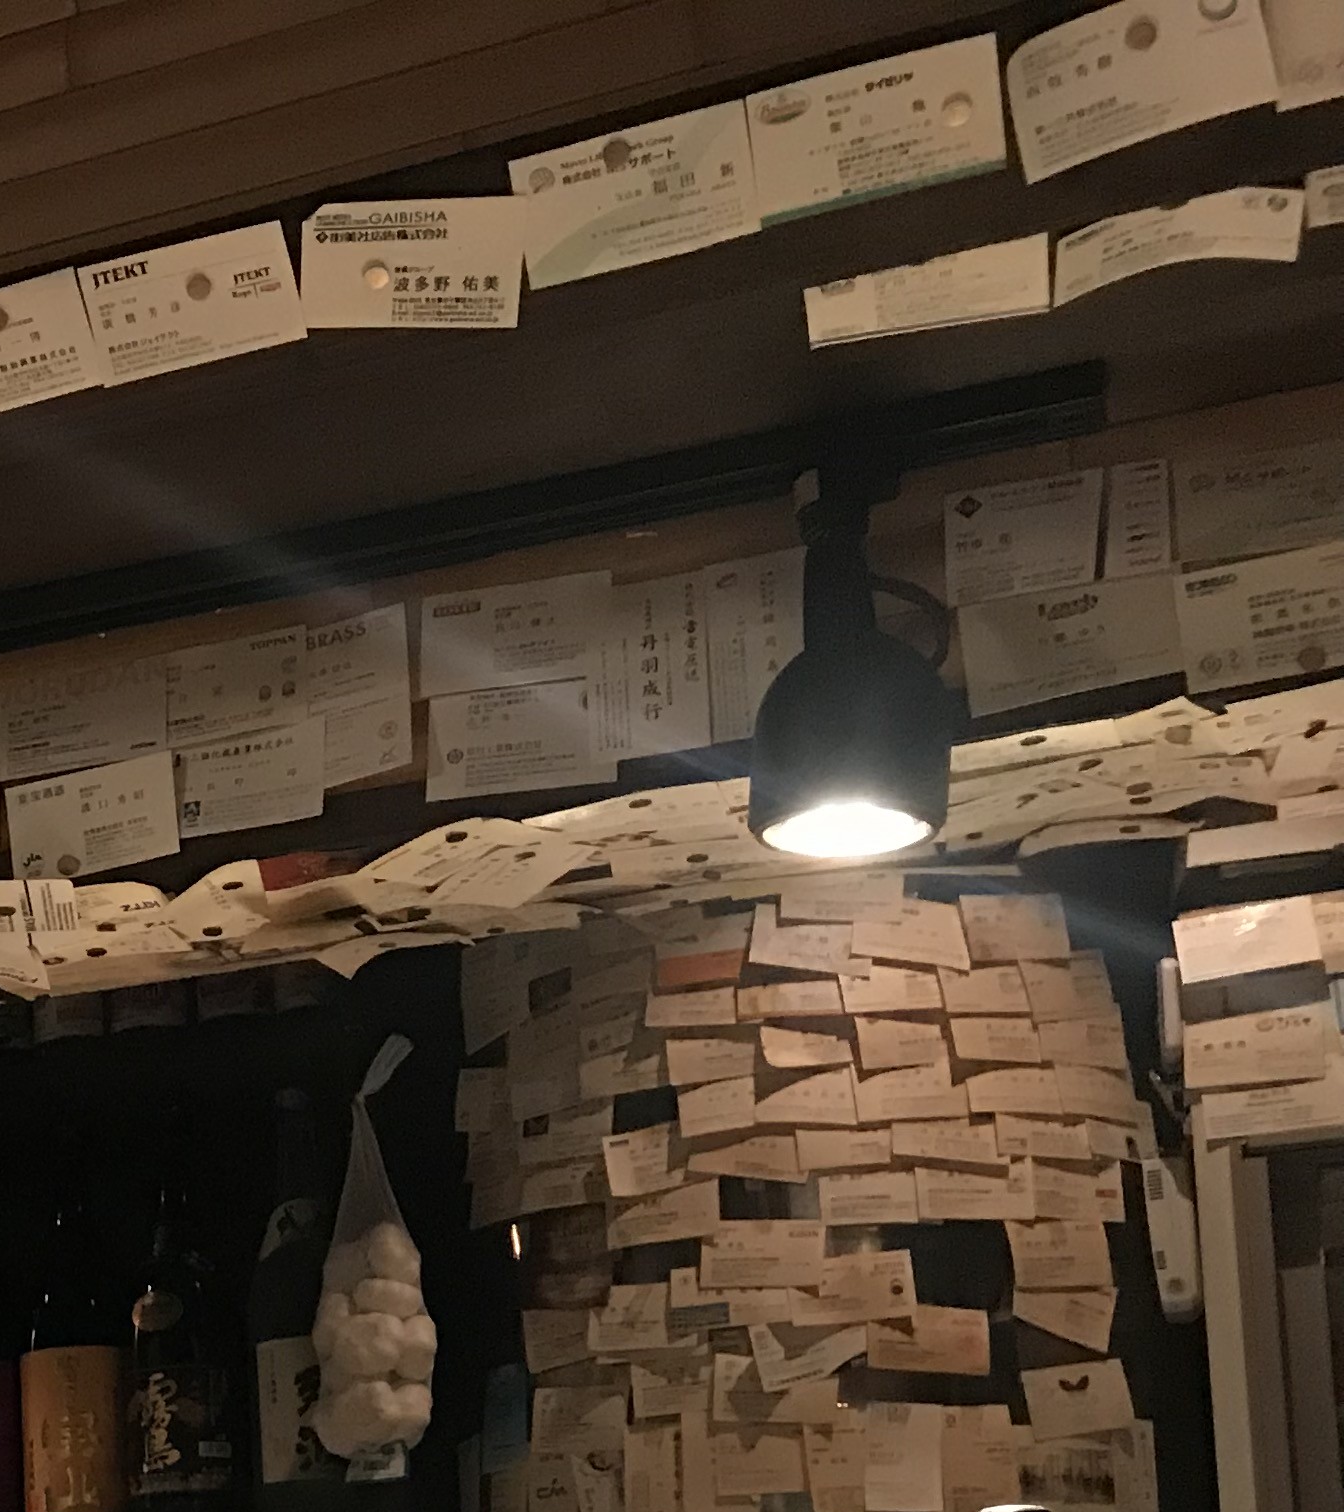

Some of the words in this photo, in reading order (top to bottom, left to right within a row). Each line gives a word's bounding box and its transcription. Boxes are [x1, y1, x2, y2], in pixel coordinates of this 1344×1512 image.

[368, 211, 448, 225] GAIBISHA
[91, 260, 150, 290] JTEKT
[232, 266, 271, 285] JTEKT
[305, 622, 367, 651] BRASS
